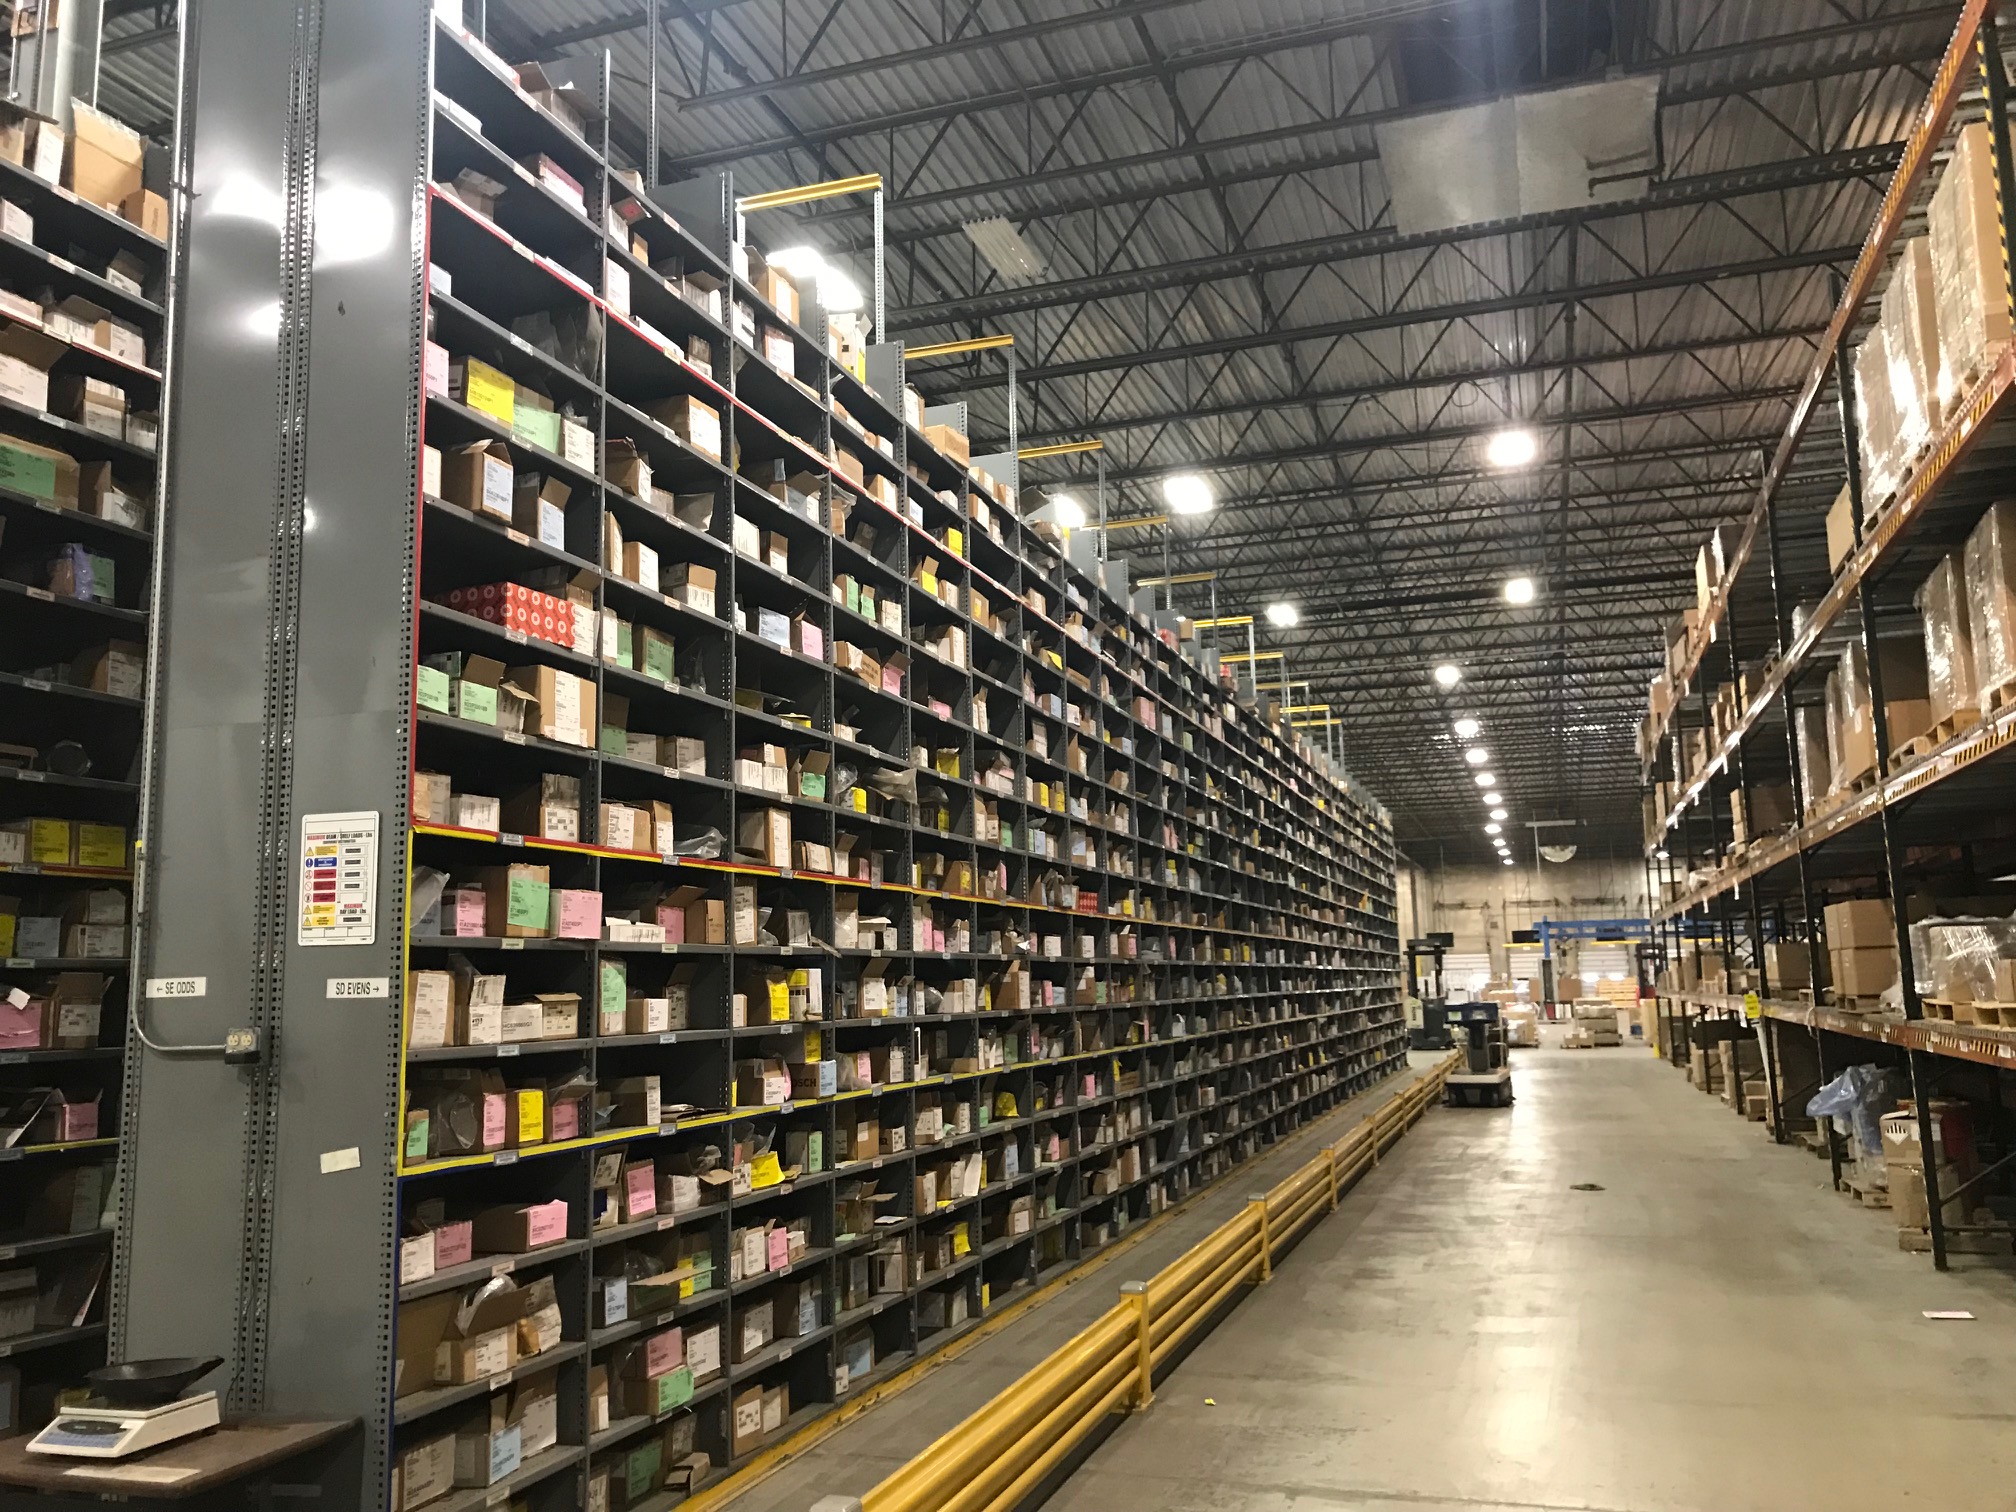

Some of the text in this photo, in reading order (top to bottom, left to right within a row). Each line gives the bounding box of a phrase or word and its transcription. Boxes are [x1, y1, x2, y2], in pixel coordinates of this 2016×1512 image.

[166, 981, 195, 994] SE ODDS
[336, 982, 370, 995] SD EVENS
[792, 1078, 816, 1088] OSCH
